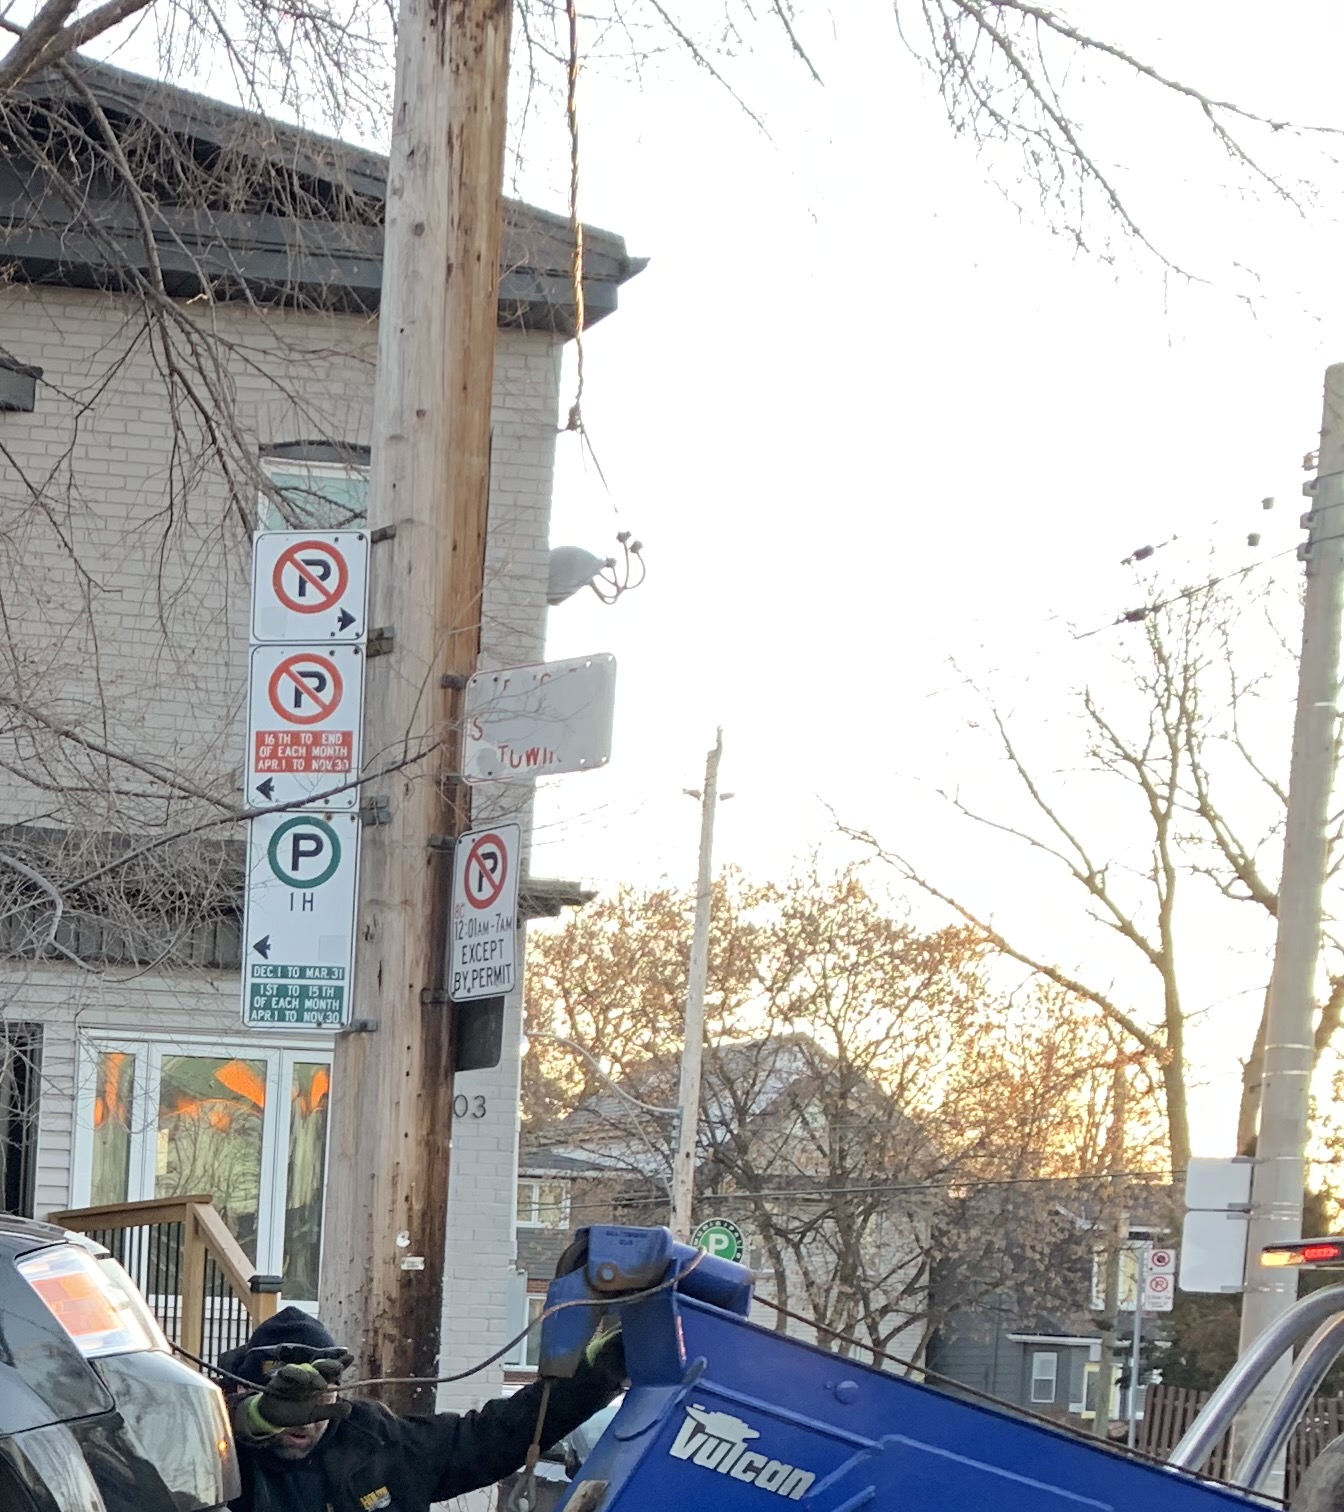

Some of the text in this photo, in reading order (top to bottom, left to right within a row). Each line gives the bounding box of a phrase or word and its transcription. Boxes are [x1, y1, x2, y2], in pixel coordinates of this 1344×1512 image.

[300, 733, 313, 744] TO
[322, 733, 343, 744] END
[259, 746, 348, 757] OF EACH MONTH
[293, 759, 305, 770] TO
[291, 833, 324, 872] P
[462, 939, 504, 965] EXCEPT
[288, 966, 300, 977] TO
[455, 963, 511, 992] BY PERMIT
[260, 984, 278, 995] 1ST
[288, 985, 300, 996] TO
[253, 997, 340, 1011] OF EACH MONTH
[285, 1011, 297, 1022] TO
[669, 1415, 816, 1500] Vulcan
